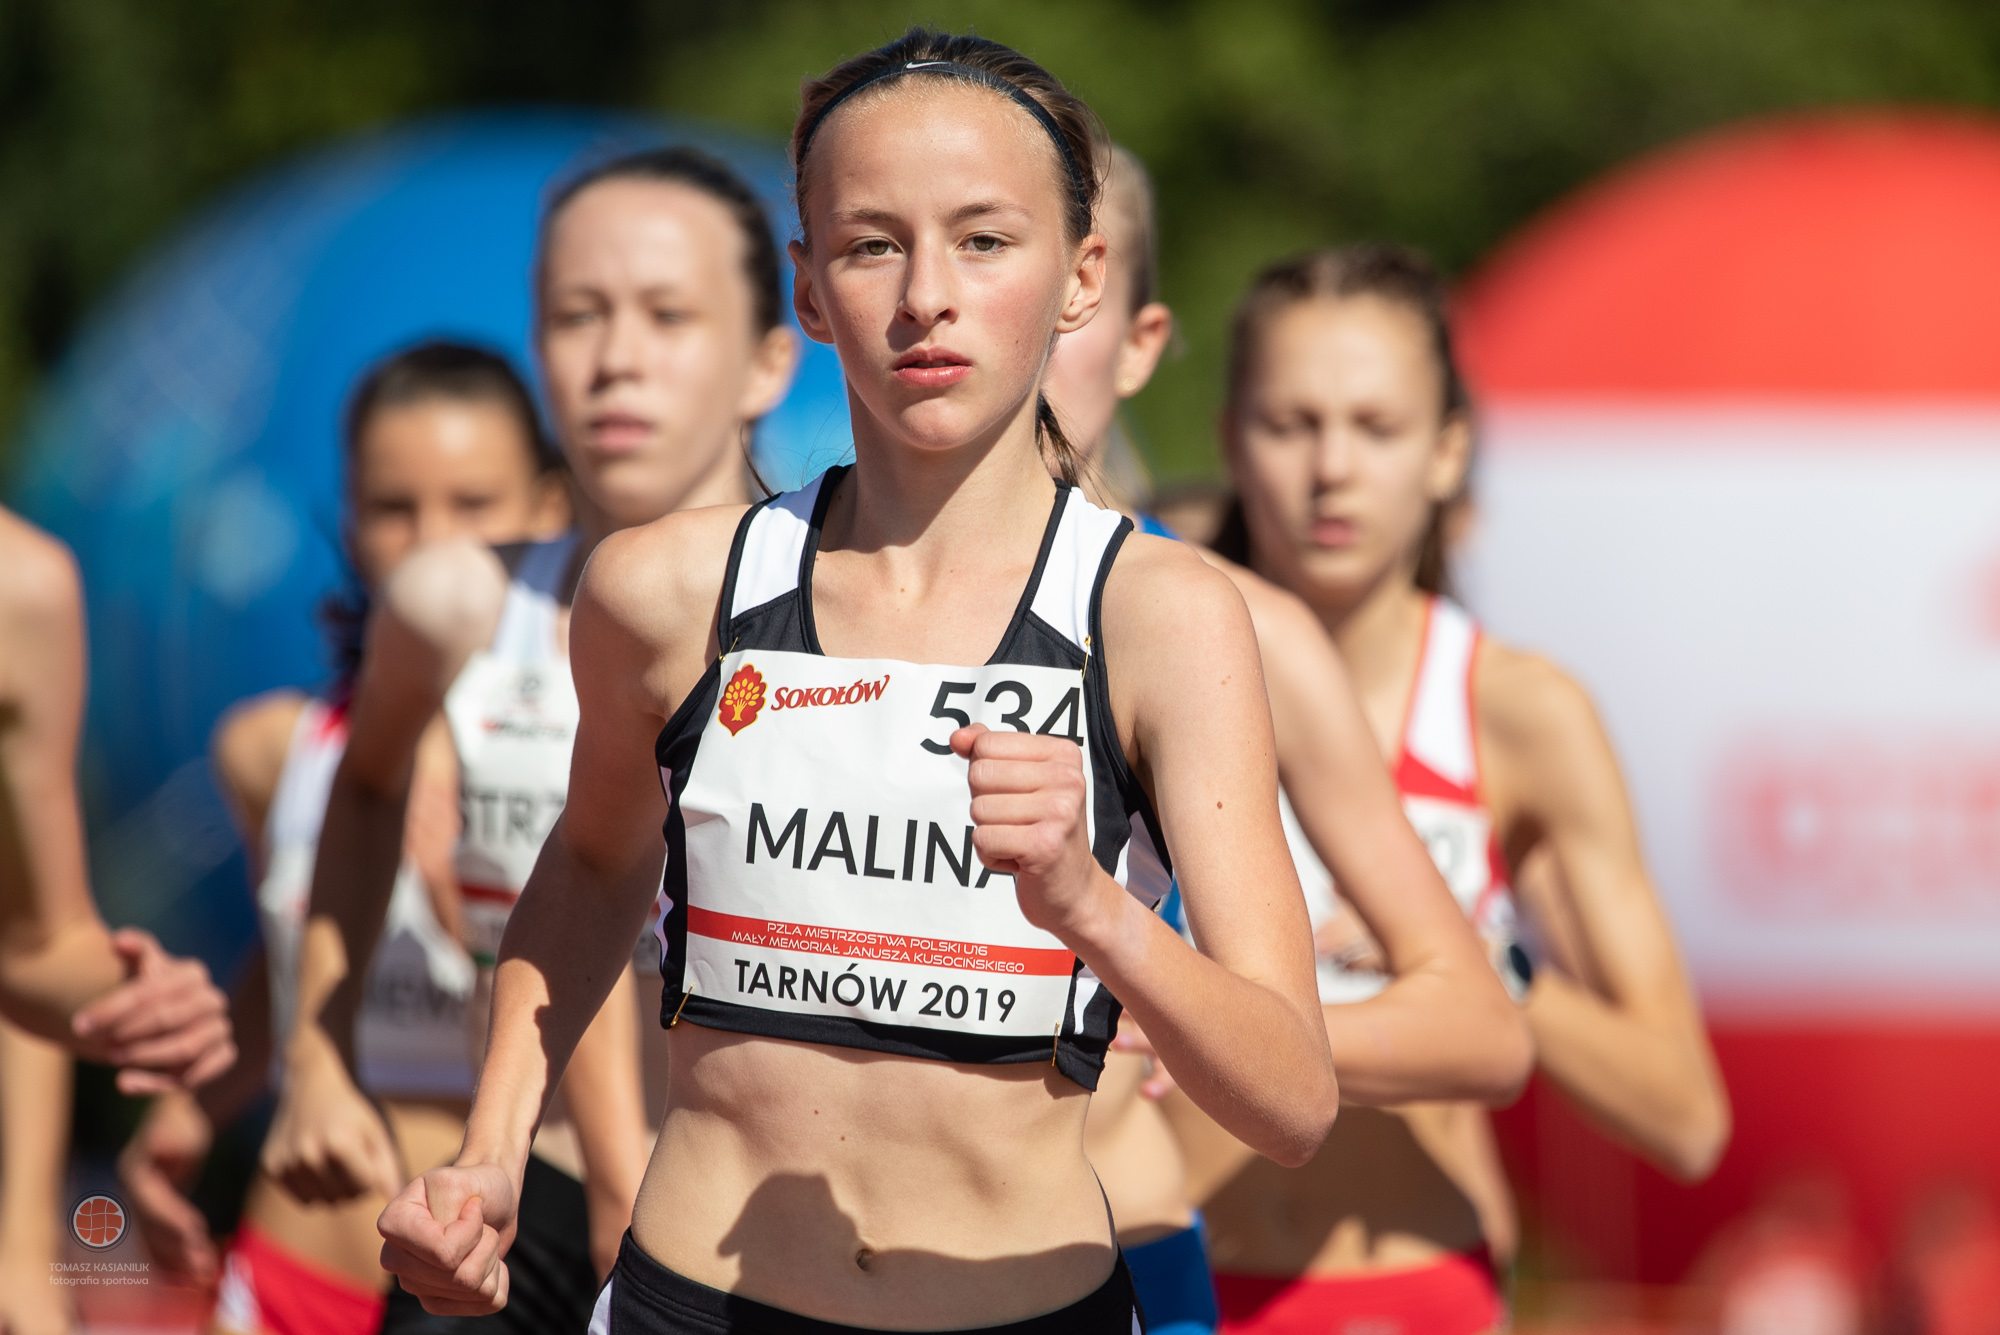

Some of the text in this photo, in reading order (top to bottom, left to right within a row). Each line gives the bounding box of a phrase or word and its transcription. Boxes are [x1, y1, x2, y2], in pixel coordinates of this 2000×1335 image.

[770, 674, 891, 711] SOKOŁÓW
[920, 680, 1085, 755] 534
[731, 931, 1025, 973] MAŁY MEMORIAŁ JANUSZA KUSOCIŃSKIEGO
[767, 922, 988, 956] PZLA MISTRZOSTWA POLSKI U16
[734, 958, 1016, 1023] TARNÓW 2019
